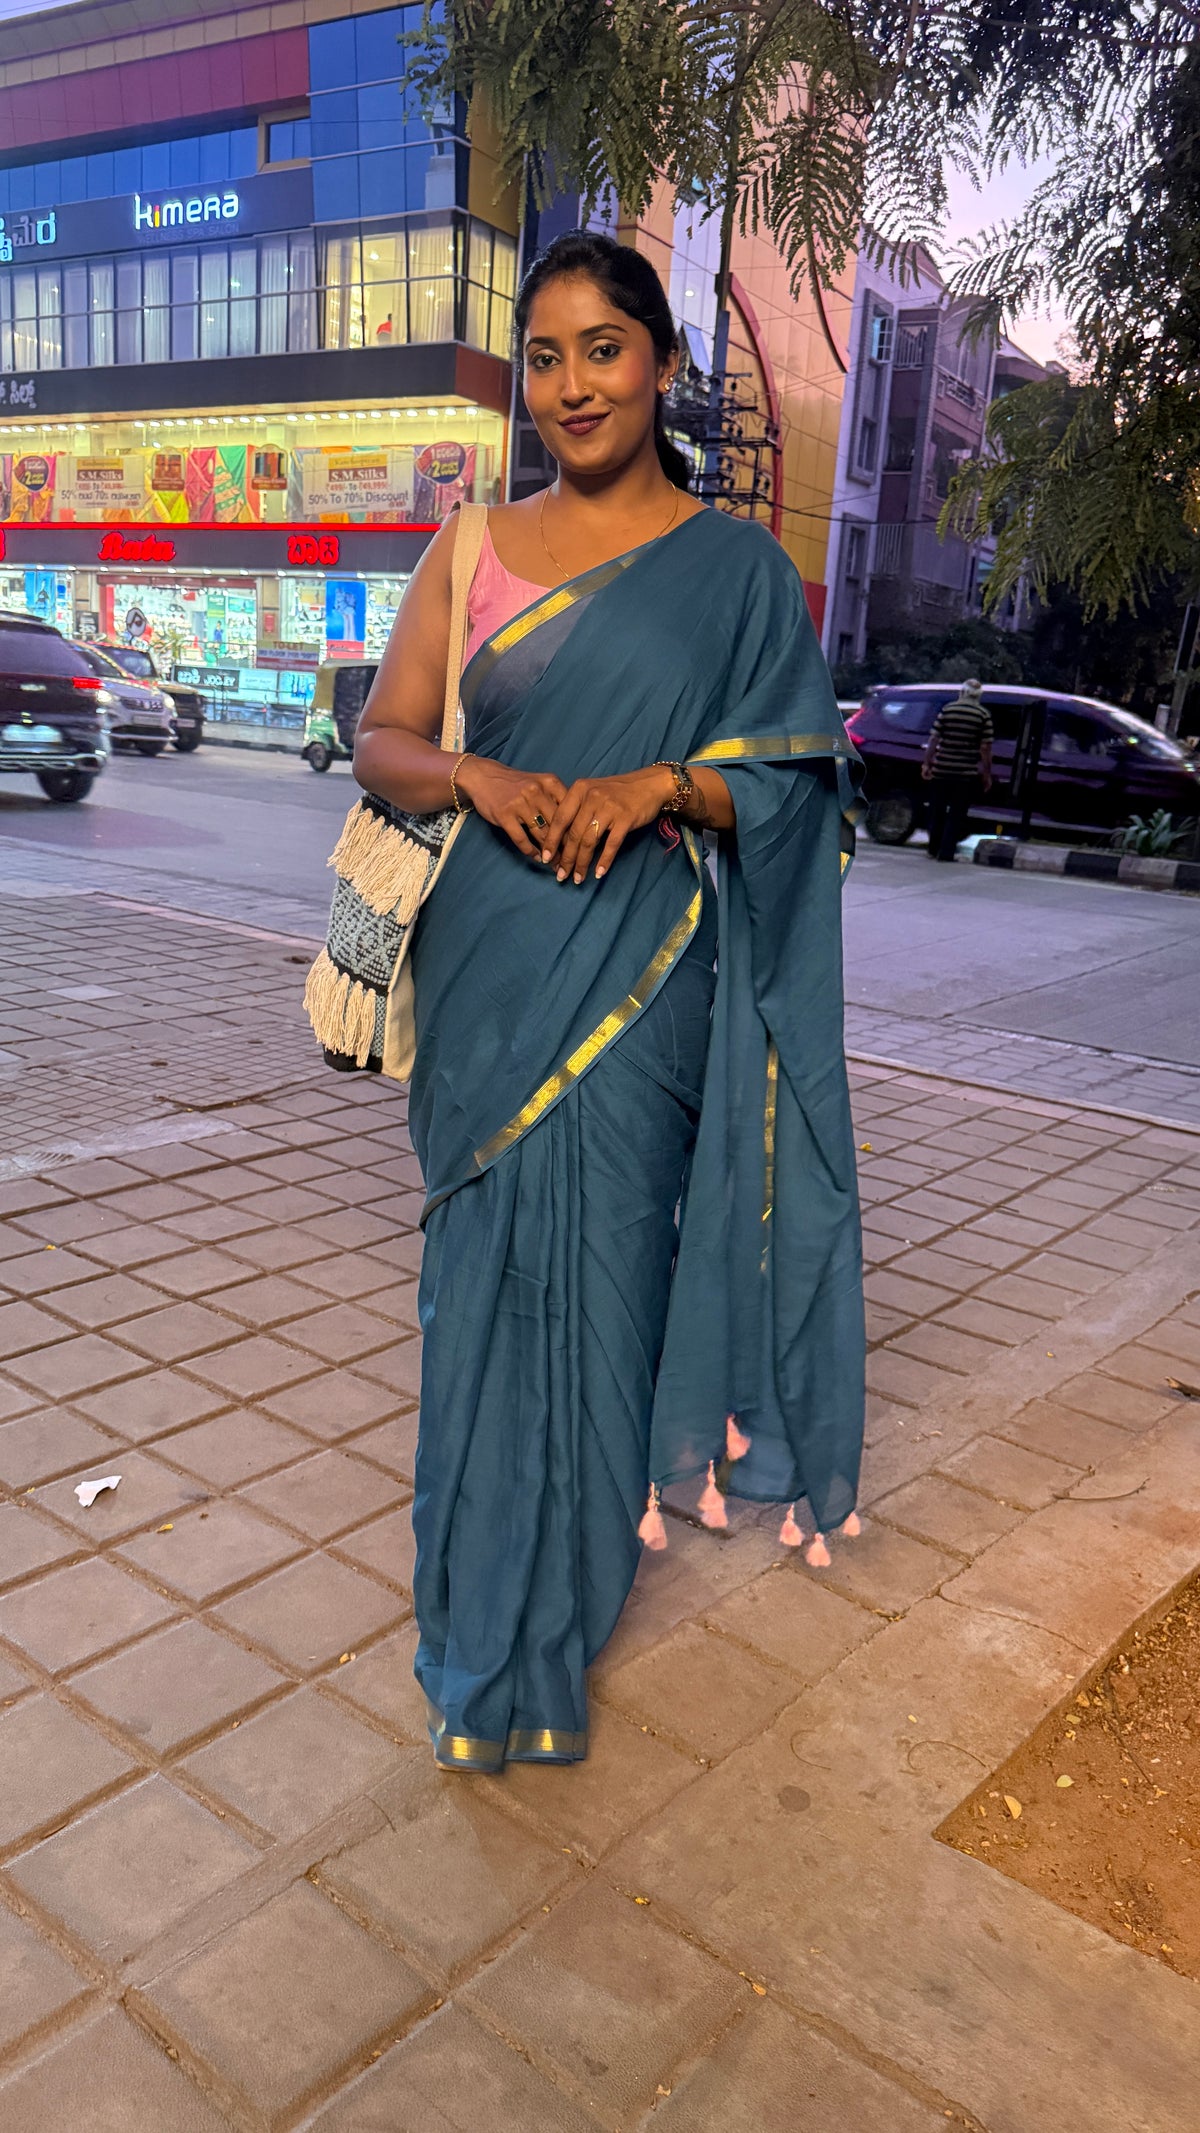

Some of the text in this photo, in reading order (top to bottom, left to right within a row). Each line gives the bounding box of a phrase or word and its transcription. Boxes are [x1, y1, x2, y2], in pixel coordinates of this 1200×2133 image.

[186, 226, 205, 238] SPA
[208, 222, 239, 235] SALON
[331, 468, 385, 481] S.M.Silks
[308, 490, 409, 505] 50% To 70% Discount
[97, 531, 176, 562] Bata
